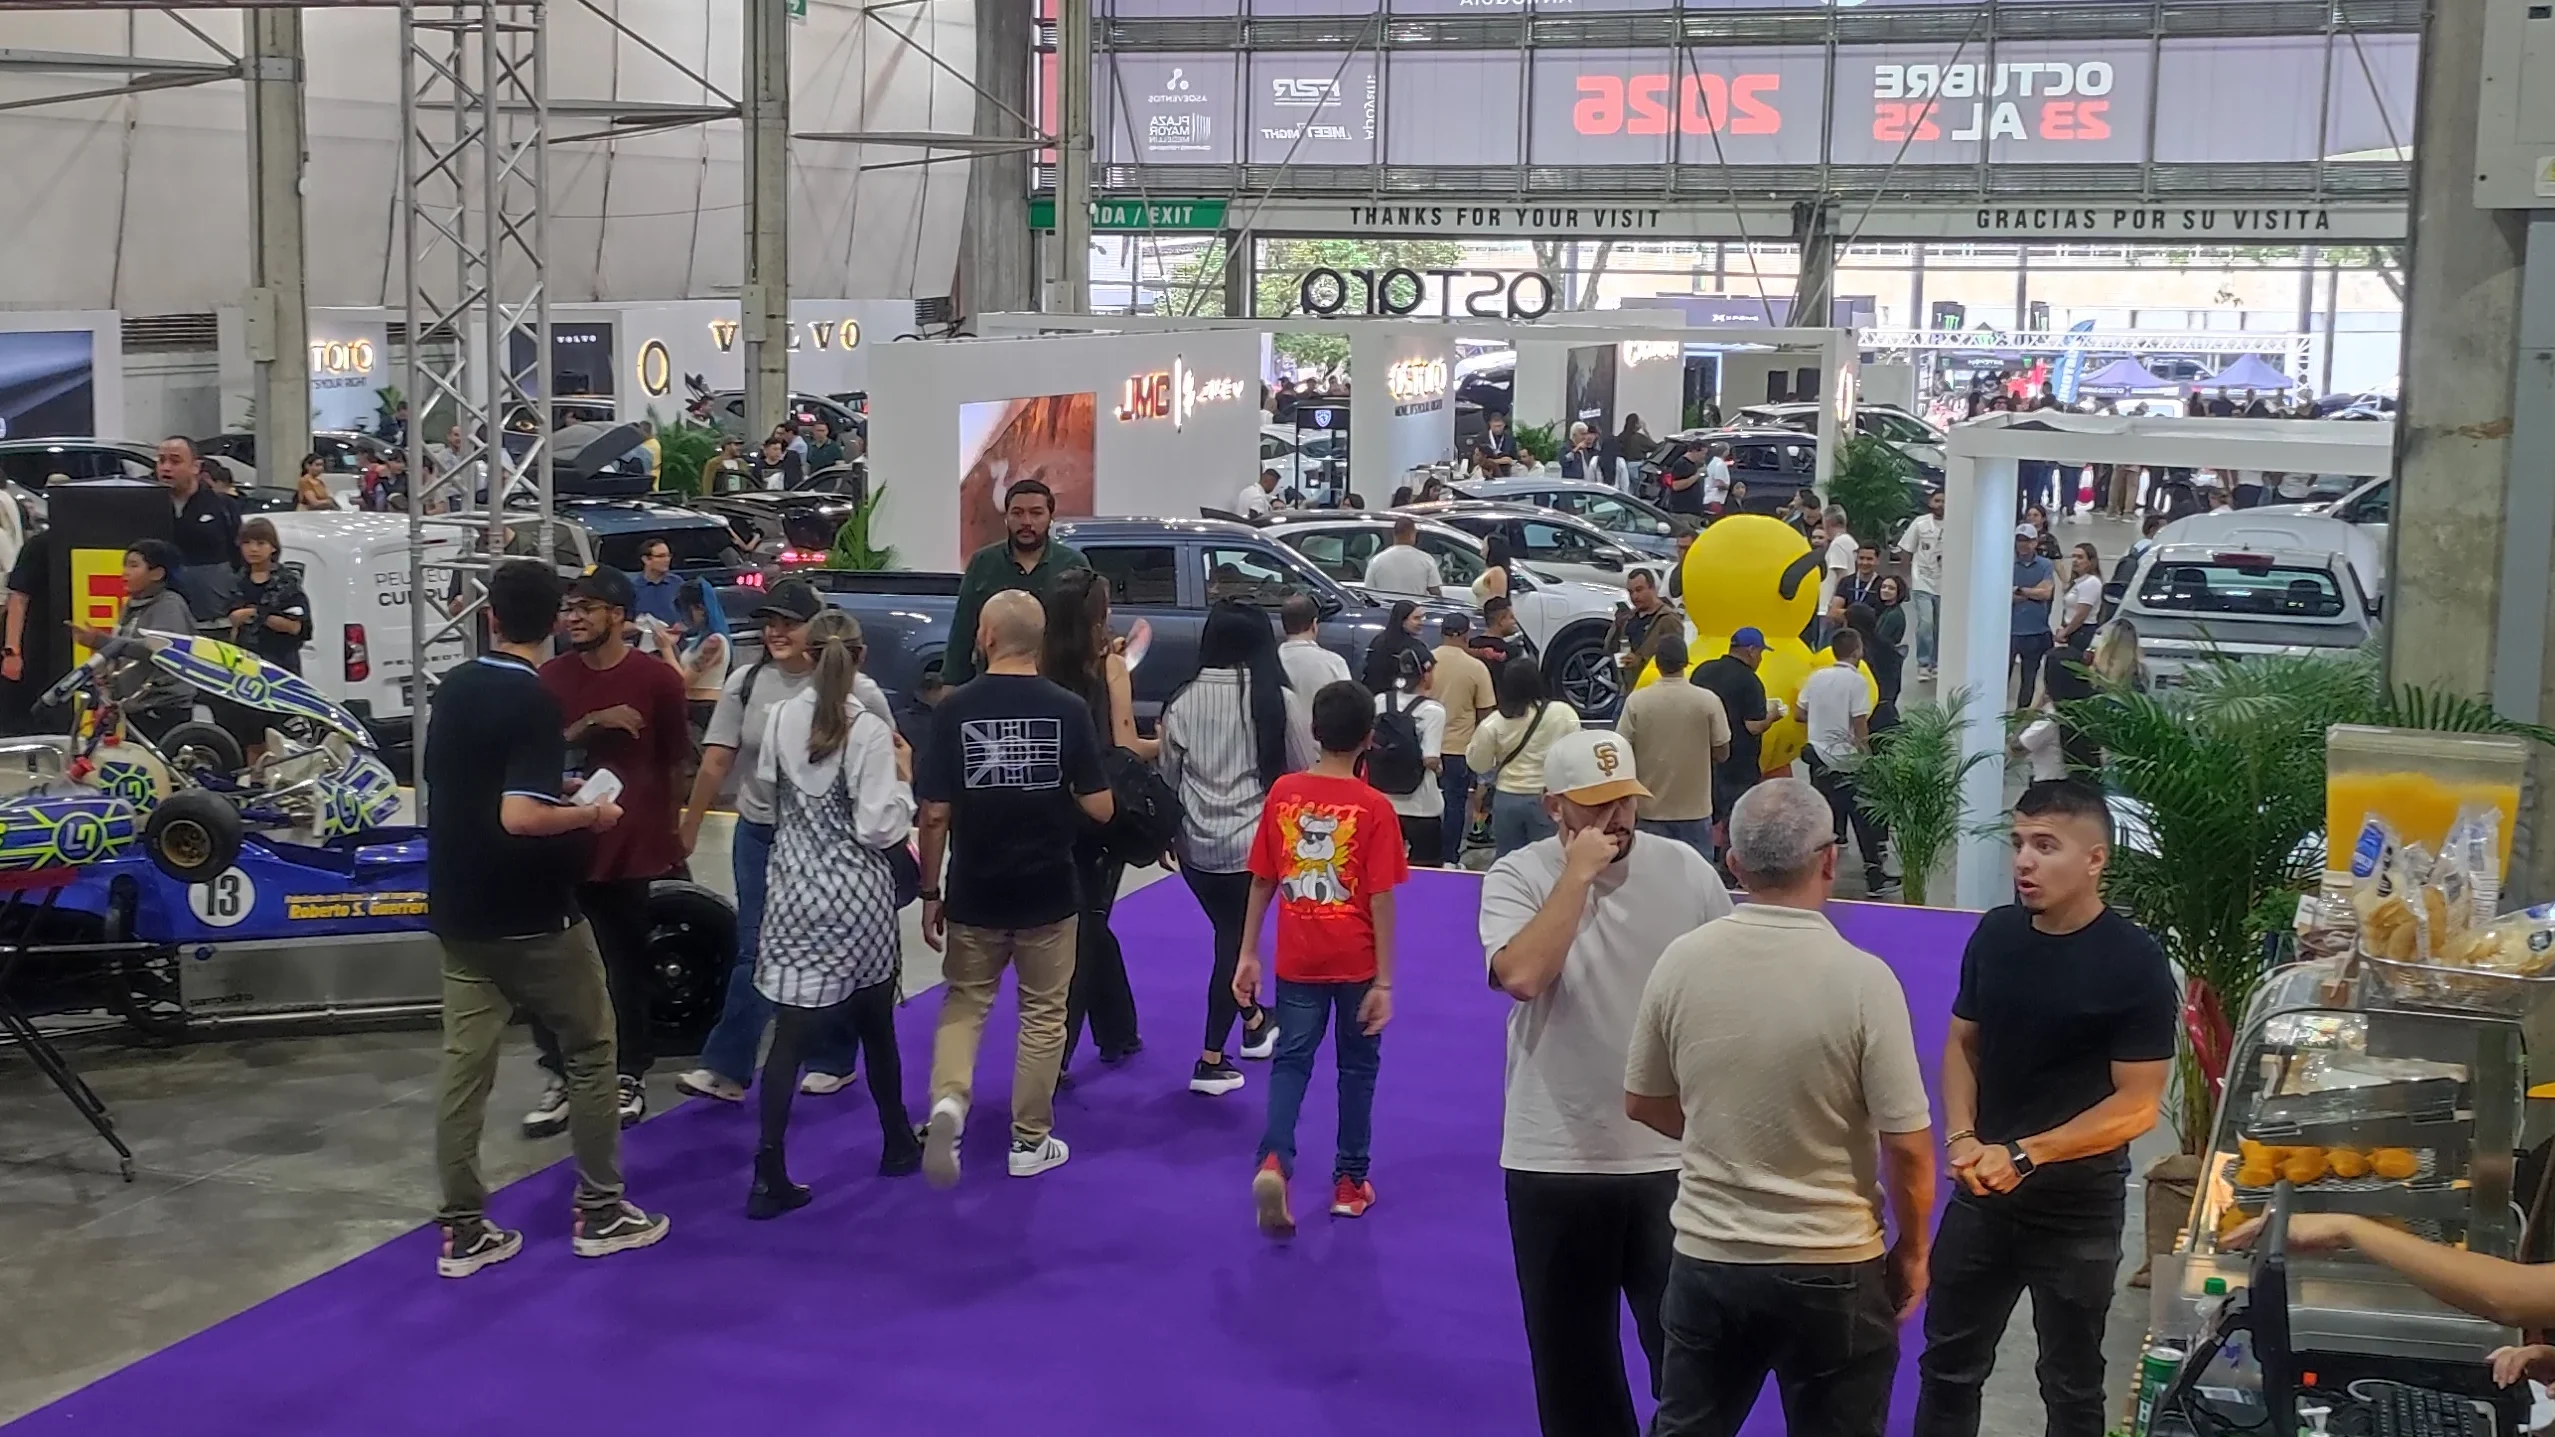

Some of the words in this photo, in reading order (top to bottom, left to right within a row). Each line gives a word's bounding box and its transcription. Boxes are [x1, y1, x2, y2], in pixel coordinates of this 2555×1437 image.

[1151, 206, 1193, 224] EXIT
[1350, 207, 1443, 227] THANKS
[1456, 207, 1501, 227] FOR
[1516, 207, 1579, 228] YOUR
[1593, 208, 1661, 229] VISIT
[1976, 209, 2096, 229] GRACIAS
[2113, 209, 2166, 229] POR
[2182, 209, 2216, 230] SU
[2233, 209, 2331, 230] VISITA
[556, 335, 597, 344] VOLVO
[707, 319, 861, 353] VLVO
[1113, 371, 1170, 421] JMC
[205, 873, 242, 917] 13
